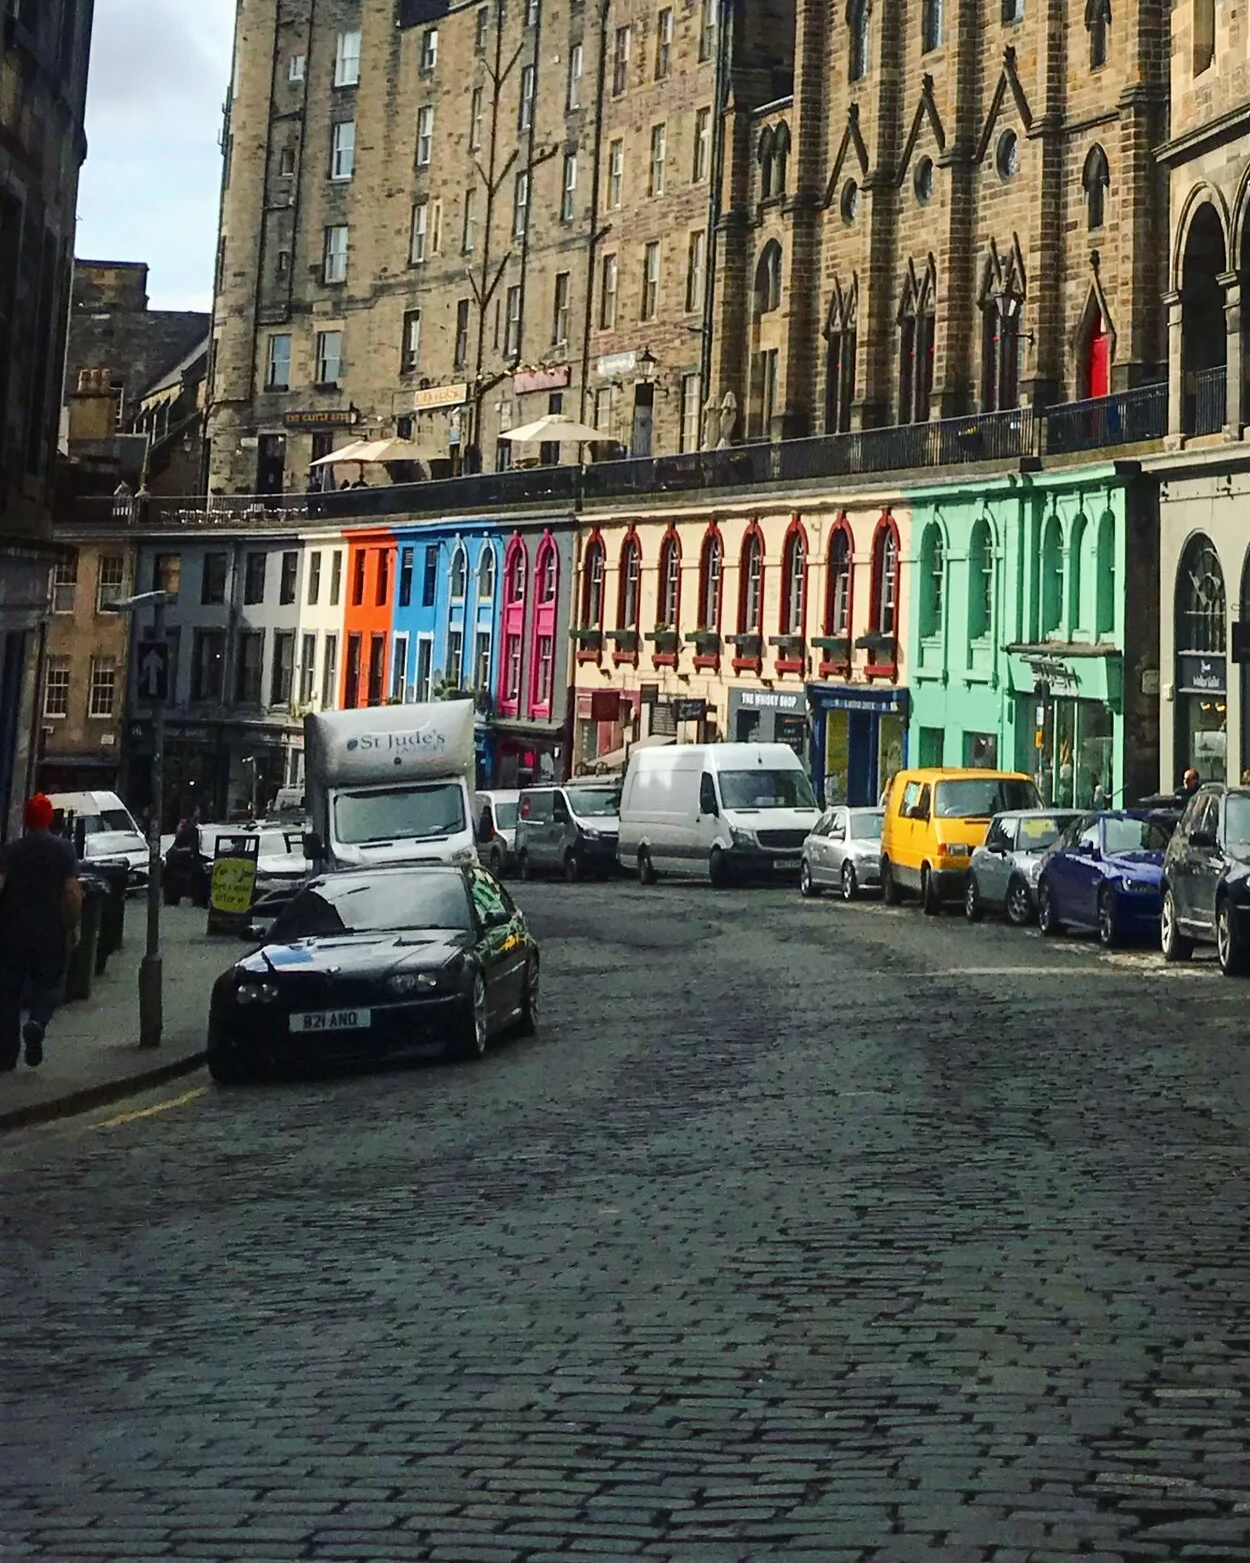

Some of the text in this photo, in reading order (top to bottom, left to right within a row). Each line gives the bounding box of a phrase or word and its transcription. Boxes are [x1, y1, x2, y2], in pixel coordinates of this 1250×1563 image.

[741, 692, 797, 708] THE WHISKY SHOP
[361, 735, 379, 749] St
[389, 729, 446, 748] Jude's
